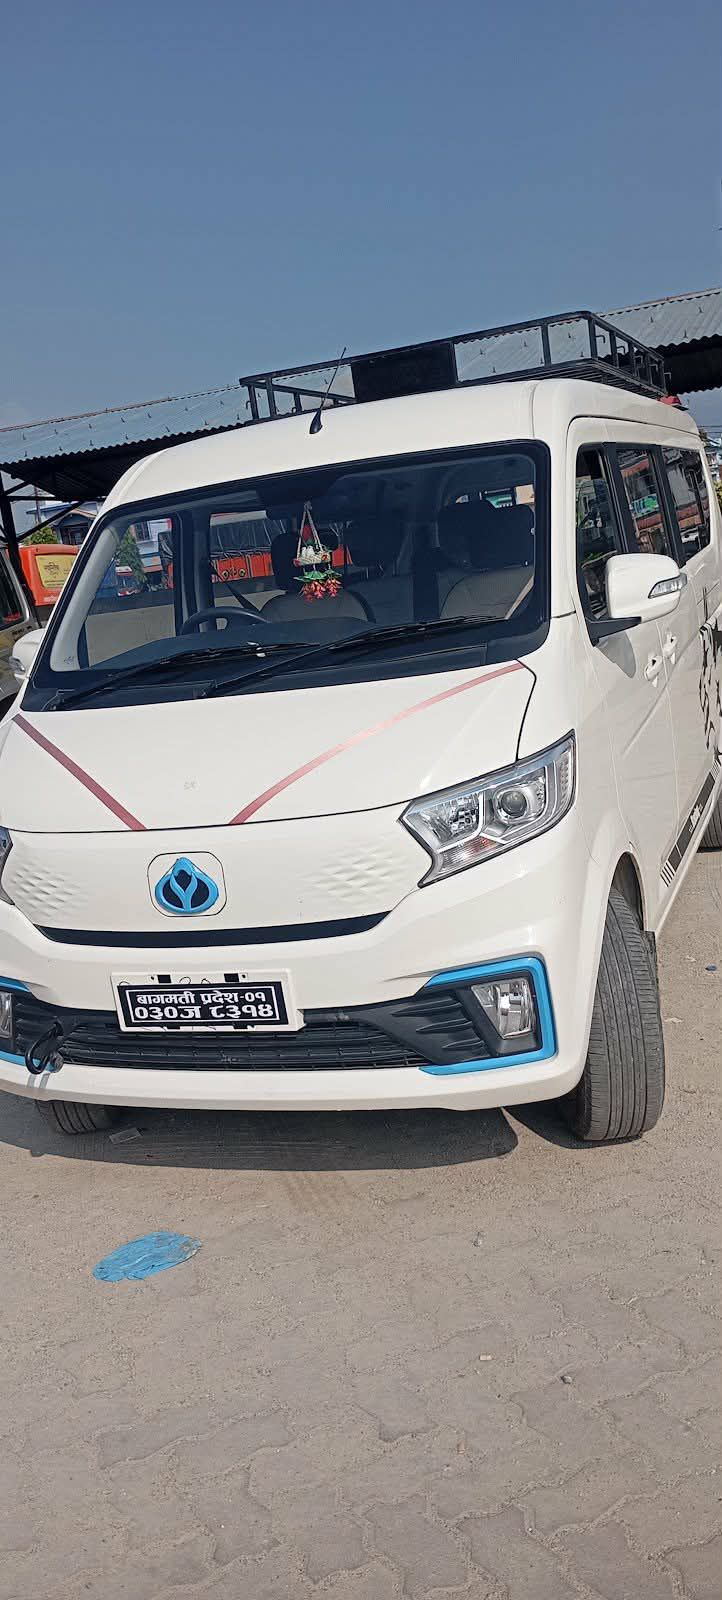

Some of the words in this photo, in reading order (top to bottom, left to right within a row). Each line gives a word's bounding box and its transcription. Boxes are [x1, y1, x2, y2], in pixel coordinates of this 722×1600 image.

[136, 991, 195, 1004] बागमती
[200, 990, 266, 1004] प्रदेश-०१
[134, 1006, 201, 1019] ०३०ज
[209, 1004, 274, 1018] ८३१४
